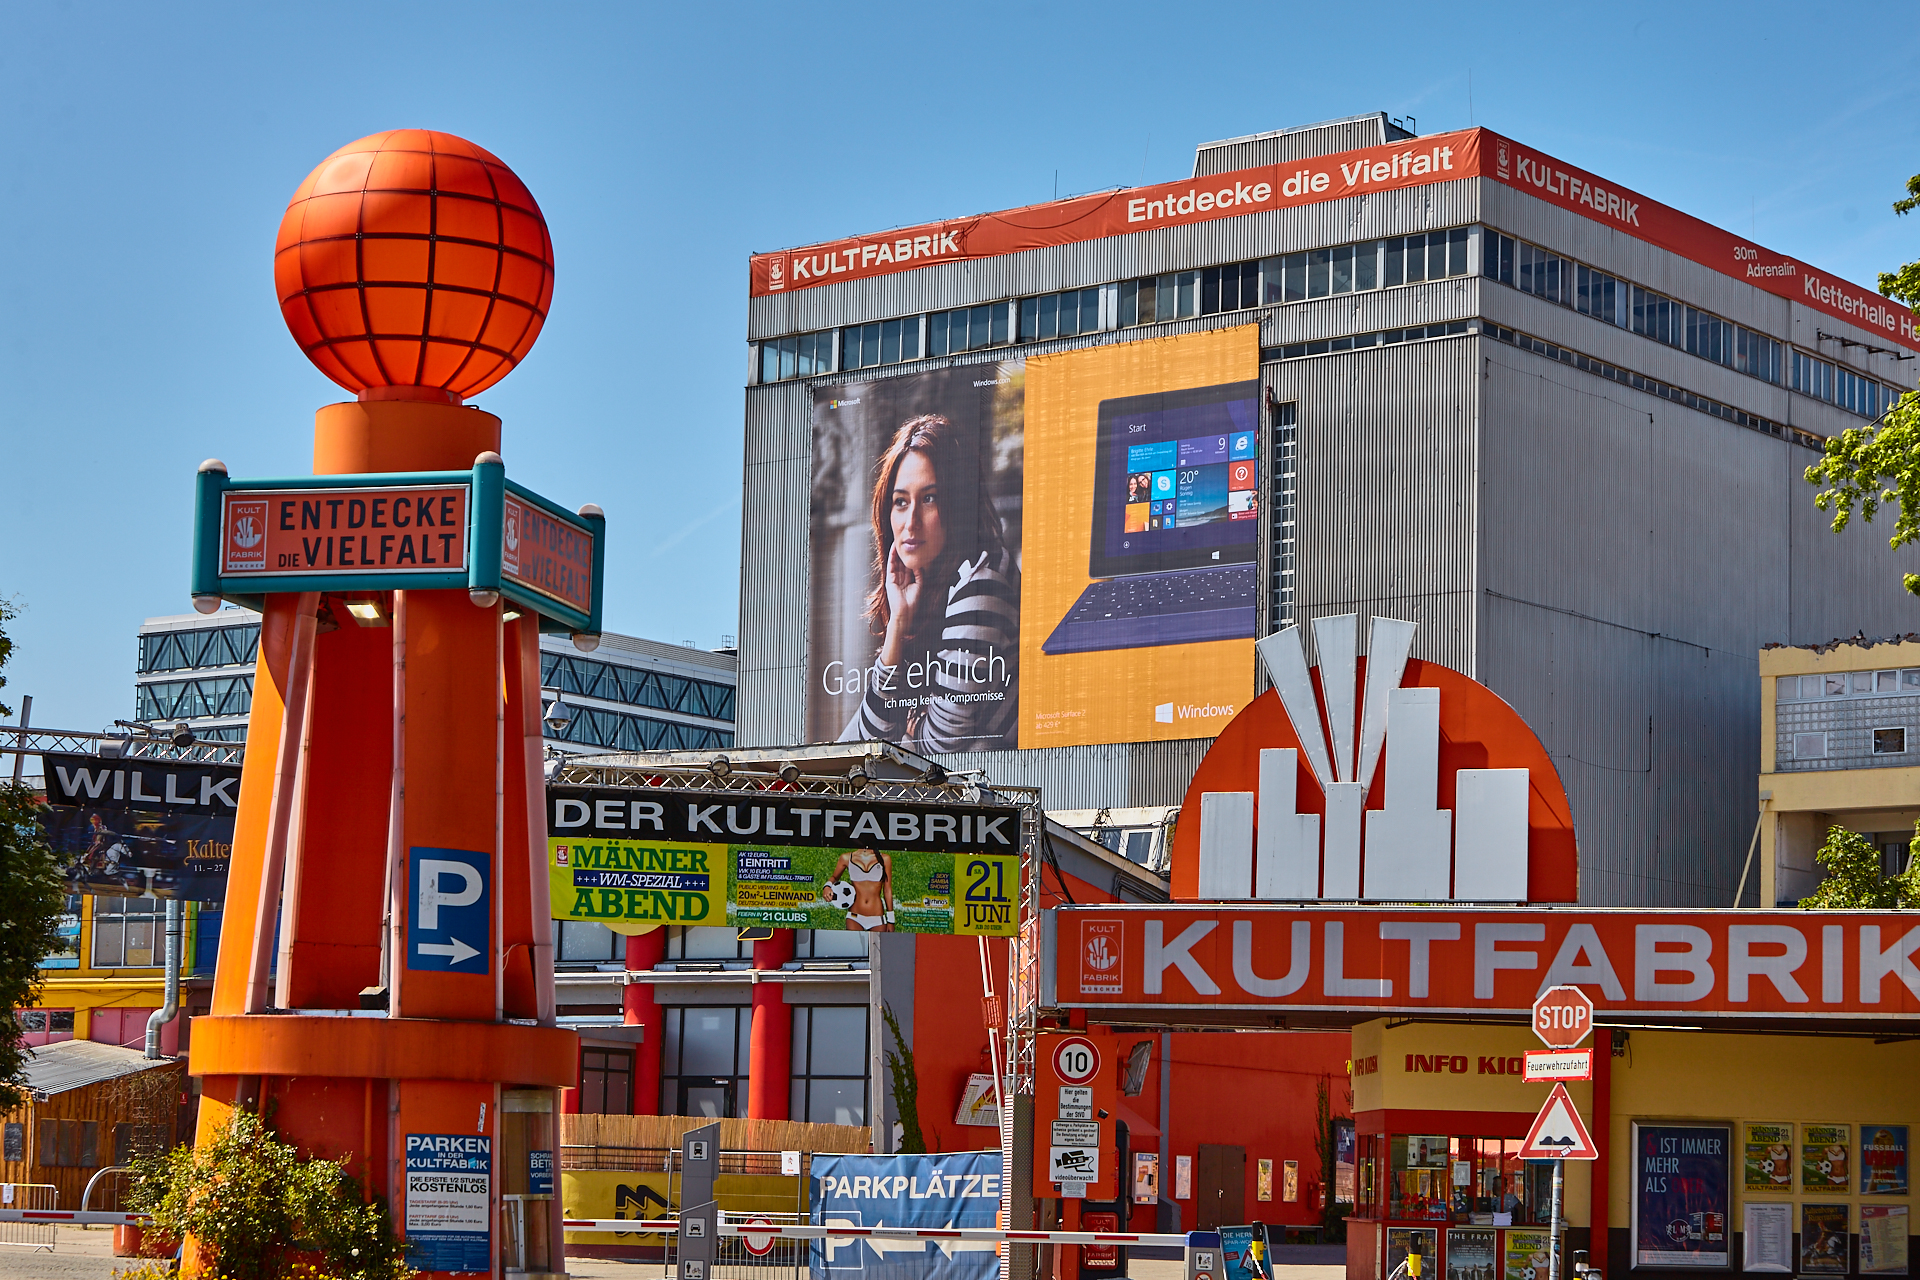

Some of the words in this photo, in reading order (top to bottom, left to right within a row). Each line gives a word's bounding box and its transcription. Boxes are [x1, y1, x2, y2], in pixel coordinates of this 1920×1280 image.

[1127, 181, 1271, 223] Entdecke
[1282, 169, 1330, 197] die
[1340, 146, 1453, 186] Vielfalt
[1516, 154, 1639, 227] KULTFABRIK
[793, 229, 959, 280] KULTFABRIK
[1733, 246, 1758, 260] 30m
[1746, 262, 1796, 277] Adrenalin
[1804, 274, 1896, 331] Kletterhalle
[973, 377, 1010, 388] Windows.com
[838, 398, 860, 407] Microsoft
[1128, 423, 1147, 434] Start
[1218, 437, 1226, 450] 9
[280, 496, 457, 531] ENTDECKE
[523, 509, 589, 569] ENTDECKE
[231, 551, 262, 559] FABRIK
[279, 554, 299, 568] DIE
[302, 534, 457, 567] VIELFALT
[532, 550, 588, 604] VIELFALT
[822, 660, 898, 696] Ganz
[906, 645, 1011, 688] ehrlich,
[884, 697, 897, 709] ich
[898, 697, 918, 709] mag
[919, 693, 943, 707] keine
[944, 690, 1006, 706] Kompromisse.
[1035, 710, 1060, 720] Microsoft
[1061, 709, 1081, 718] Surface
[1081, 709, 1086, 717] 2
[1177, 703, 1234, 719] Windows
[56, 765, 238, 807] WILLK
[555, 799, 664, 830] DER
[688, 803, 1011, 845] KULTFABRIK
[184, 839, 232, 866] Kalte
[572, 840, 709, 873] MÄNNER
[194, 864, 206, 872] 11.
[214, 864, 226, 872] 27.
[745, 858, 788, 868] EINTRITT
[599, 872, 682, 889] WM-SPEZIAL
[964, 860, 1011, 903] 21.
[418, 859, 483, 930] P
[931, 897, 948, 905] rhino's
[570, 888, 709, 921] ABEND
[762, 912, 773, 921] 21
[774, 912, 808, 922] CLUBS
[963, 904, 1011, 927] JUNI
[1089, 925, 1116, 933] KULT
[1143, 919, 1920, 1004] KULTFABRIK
[1083, 973, 1119, 982] FABRIK
[1538, 1005, 1587, 1029] STOP
[1065, 1051, 1088, 1073] 10
[1355, 1058, 1364, 1077] INFO
[1365, 1055, 1378, 1075] KIOSK
[1405, 1054, 1468, 1074] INFO
[1527, 1059, 1588, 1071] Feuerwehrzufahrt
[1060, 1103, 1091, 1111] Bestimmungen
[1751, 1135, 1781, 1143] ABEND
[1808, 1127, 1836, 1135] MÄNNER
[407, 1136, 490, 1153] PARKEN
[1660, 1138, 1676, 1154] IST
[1681, 1137, 1721, 1155] IMMER
[1645, 1157, 1679, 1174] MEHR
[1864, 1150, 1904, 1166] WM
[410, 1182, 487, 1194] KOSTENLOS
[820, 1169, 1000, 1199] PARKPLÄTZE
[1645, 1177, 1667, 1193] ALS
[1401, 1192, 1419, 1205] 24
[1399, 1208, 1445, 1218] Geöffnet
[1512, 1242, 1542, 1250] ABEND
